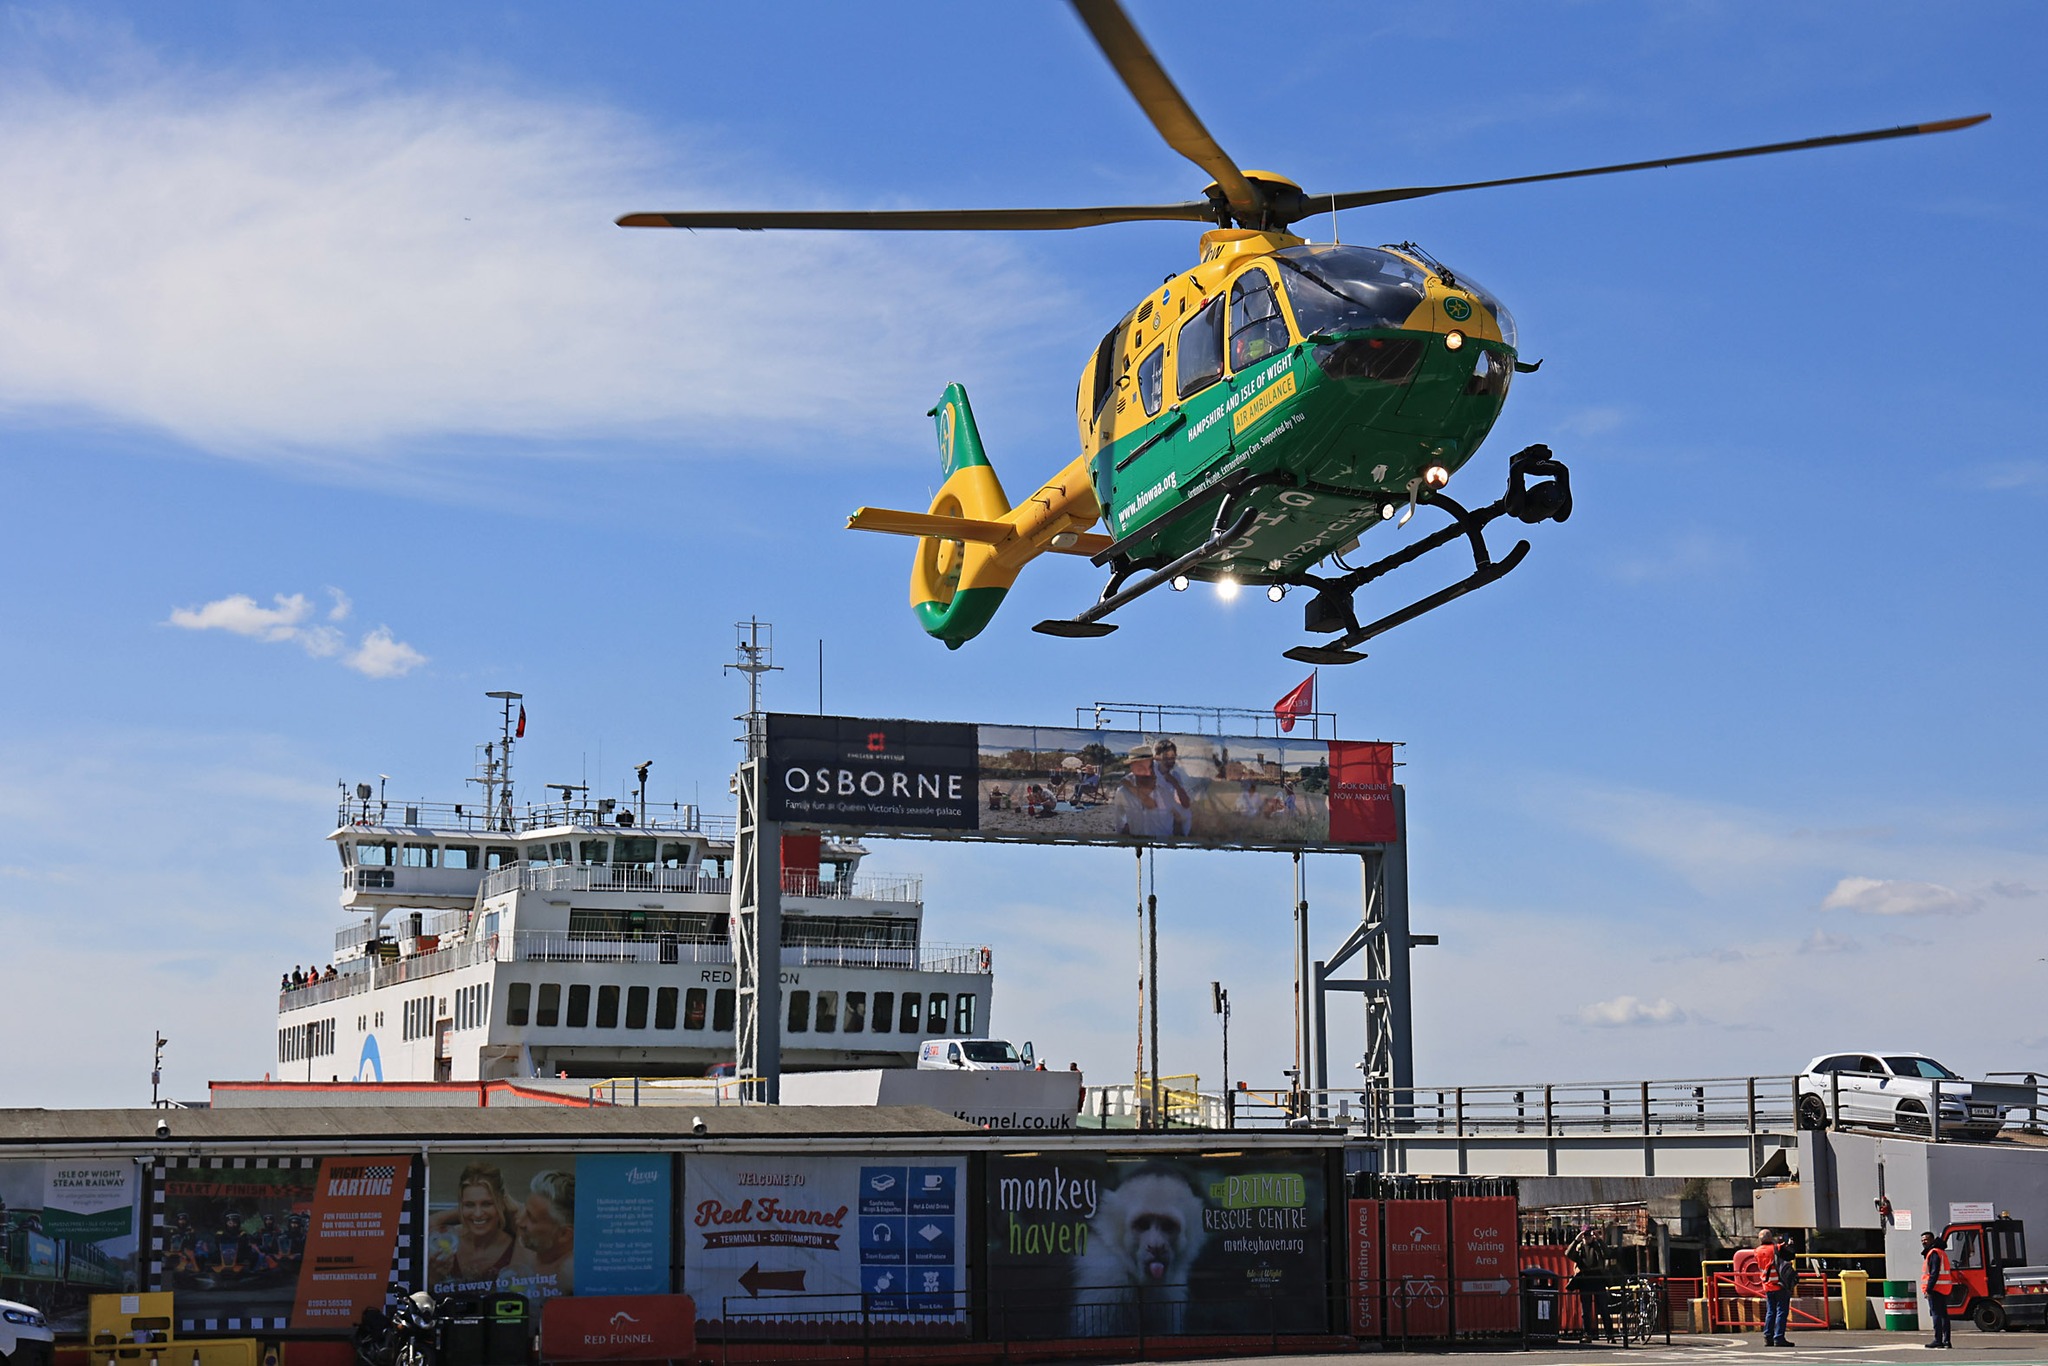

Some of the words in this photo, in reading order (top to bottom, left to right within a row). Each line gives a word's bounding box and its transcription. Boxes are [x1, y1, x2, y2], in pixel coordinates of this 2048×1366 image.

[1187, 403, 1226, 443] HAMPSHIRE
[1225, 396, 1240, 414] AND
[1240, 380, 1256, 403] ISLE
[1256, 371, 1266, 389] OF
[1266, 353, 1293, 381] WIGHT
[1234, 411, 1248, 429] AIR
[1249, 377, 1293, 421] AMBULANCE
[1220, 453, 1250, 477] Extraordinary
[1248, 443, 1262, 457] Care.
[1260, 426, 1285, 447] Supported
[1284, 419, 1295, 432] by
[1291, 411, 1306, 426] You
[1118, 471, 1177, 524] www.hiowaa.org
[785, 766, 963, 800] OSBORNE
[1337, 782, 1358, 790] BOOK
[1358, 782, 1388, 791] ONLINE
[1333, 792, 1353, 801] NOW
[1354, 793, 1371, 801] AND
[1372, 794, 1391, 802] SAVE
[785, 799, 810, 813] Family
[812, 800, 826, 810] fun
[838, 802, 867, 814] Queen
[867, 803, 905, 815] Victoria's
[906, 805, 935, 815] seaside
[935, 807, 963, 818] palace
[701, 970, 732, 983] RED
[642, 1050, 648, 1058] 2
[58, 1170, 76, 1179] ISLE
[78, 1170, 90, 1179] OF
[91, 1170, 122, 1179] WIGHT
[329, 1166, 365, 1179] WIGHT
[625, 1167, 659, 1183] Away
[738, 1172, 791, 1187] WELCOME
[791, 1173, 806, 1187] TO
[53, 1179, 84, 1188] STEAM
[85, 1179, 125, 1188] RAILWAY
[169, 1183, 212, 1196] START
[225, 1184, 267, 1196] FINISH
[327, 1179, 394, 1197] KARTING
[1000, 1166, 1097, 1219] monkey
[1211, 1184, 1226, 1197] THE
[1228, 1176, 1303, 1207] PRIMATE
[336, 1212, 360, 1220] FUELLED
[694, 1198, 753, 1228] Red
[756, 1196, 849, 1230] Funnel
[1205, 1208, 1253, 1231] RESCUE
[1258, 1207, 1307, 1231] CENTRE
[322, 1221, 334, 1229] FOR
[334, 1221, 356, 1229] YOUNG,
[1357, 1207, 1369, 1238] Area
[358, 1229, 385, 1237] BETWEEN
[719, 1234, 757, 1245] TERMINAL
[757, 1234, 762, 1243] 1
[769, 1234, 823, 1245] SOUTHAMPTON
[1009, 1211, 1088, 1256] haven
[1473, 1227, 1499, 1240] Cycle
[1223, 1235, 1304, 1255] monkeyhaven.org
[1391, 1243, 1409, 1252] RED
[1410, 1243, 1443, 1252] FUNNEL
[1467, 1241, 1505, 1253] Waiting
[1357, 1239, 1372, 1292] Waiting
[1475, 1255, 1498, 1266] Area
[433, 1282, 457, 1295] Get
[457, 1279, 494, 1294] away
[495, 1276, 509, 1288] to
[510, 1272, 557, 1287] having
[525, 1288, 541, 1299] to
[542, 1286, 564, 1298] be.
[584, 1334, 607, 1346] RED
[610, 1333, 655, 1345] FUNNEL
